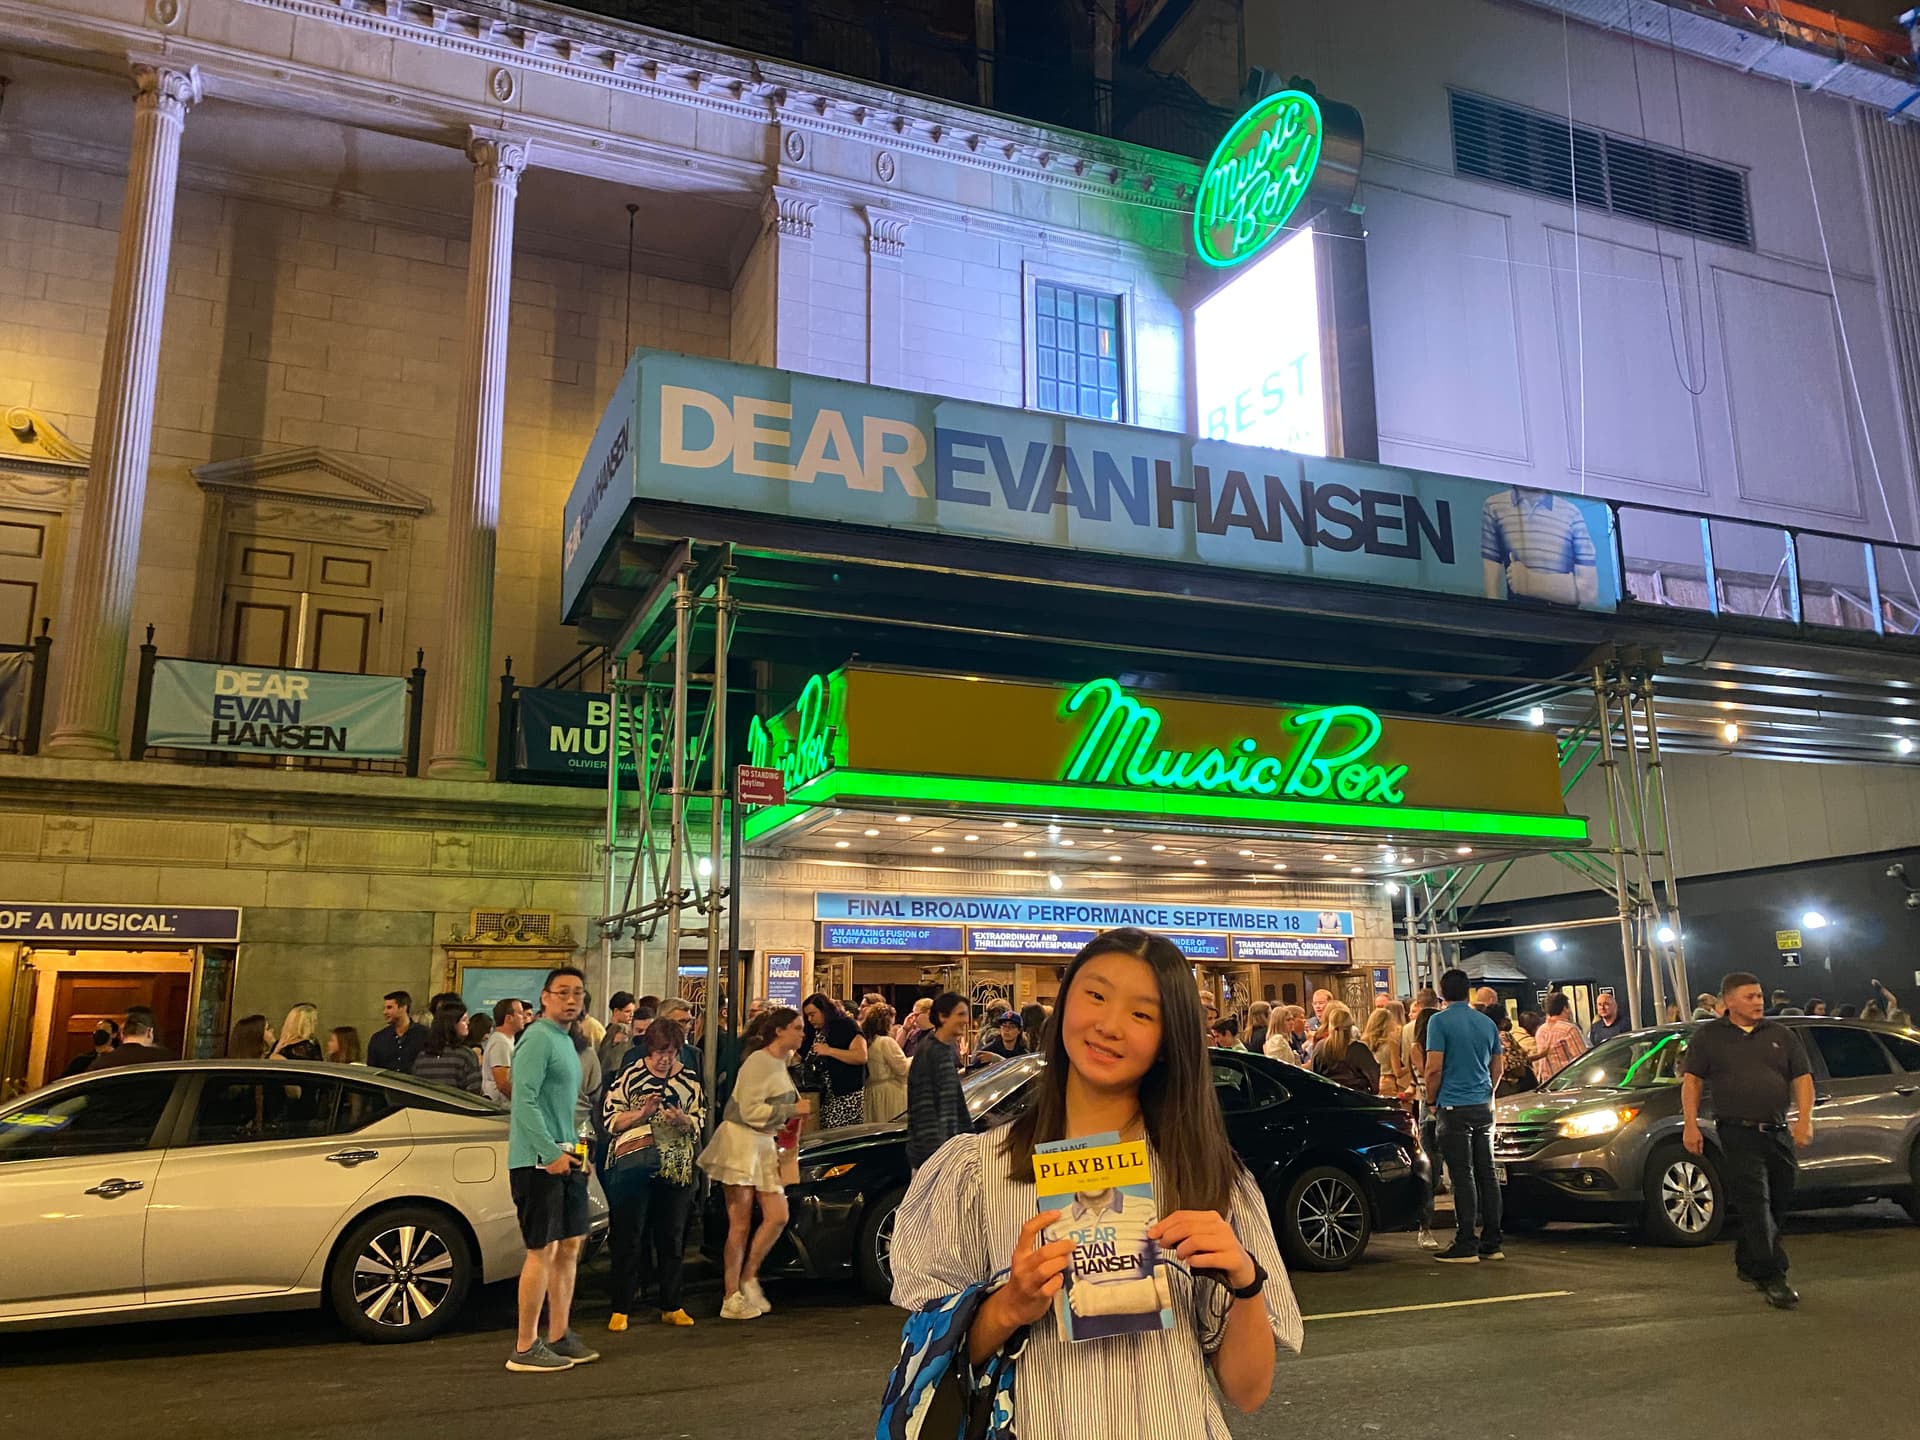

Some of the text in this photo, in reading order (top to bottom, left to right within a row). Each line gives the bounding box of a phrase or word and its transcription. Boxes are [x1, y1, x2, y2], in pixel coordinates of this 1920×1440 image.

[1208, 103, 1300, 225] Music
[1226, 134, 1311, 254] Box
[1207, 352, 1310, 441] BEST
[660, 384, 1456, 564] DEAR EVAN HANSEN
[215, 669, 310, 700] DEAR
[213, 694, 301, 724] EVAN
[210, 720, 348, 752] HANSEN
[1066, 678, 1409, 803] Music Box
[568, 759, 608, 769] OLIVIER
[740, 769, 779, 780] NO STANDING
[741, 778, 765, 788] Anytime
[0, 911, 32, 929] OF
[36, 911, 55, 930] A
[847, 899, 1300, 931] FINAL BROADWAY PERFORMANCE SEPTEMBER 18
[831, 936, 860, 944] STORY
[861, 937, 879, 945] AND
[846, 928, 885, 937] AMAZING
[886, 930, 917, 938] FUSION
[1041, 934, 1058, 942] AND
[975, 940, 1024, 949] THRILLINGLY
[1255, 948, 1297, 956] THRILLINGLY
[770, 957, 791, 965] DEAR
[769, 970, 800, 978] HANSEN
[1040, 1152, 1143, 1179] PLAYBILL
[1069, 1226, 1117, 1244] DEAR
[1072, 1241, 1116, 1261] EVAN
[1074, 1253, 1143, 1276] HANSEN
